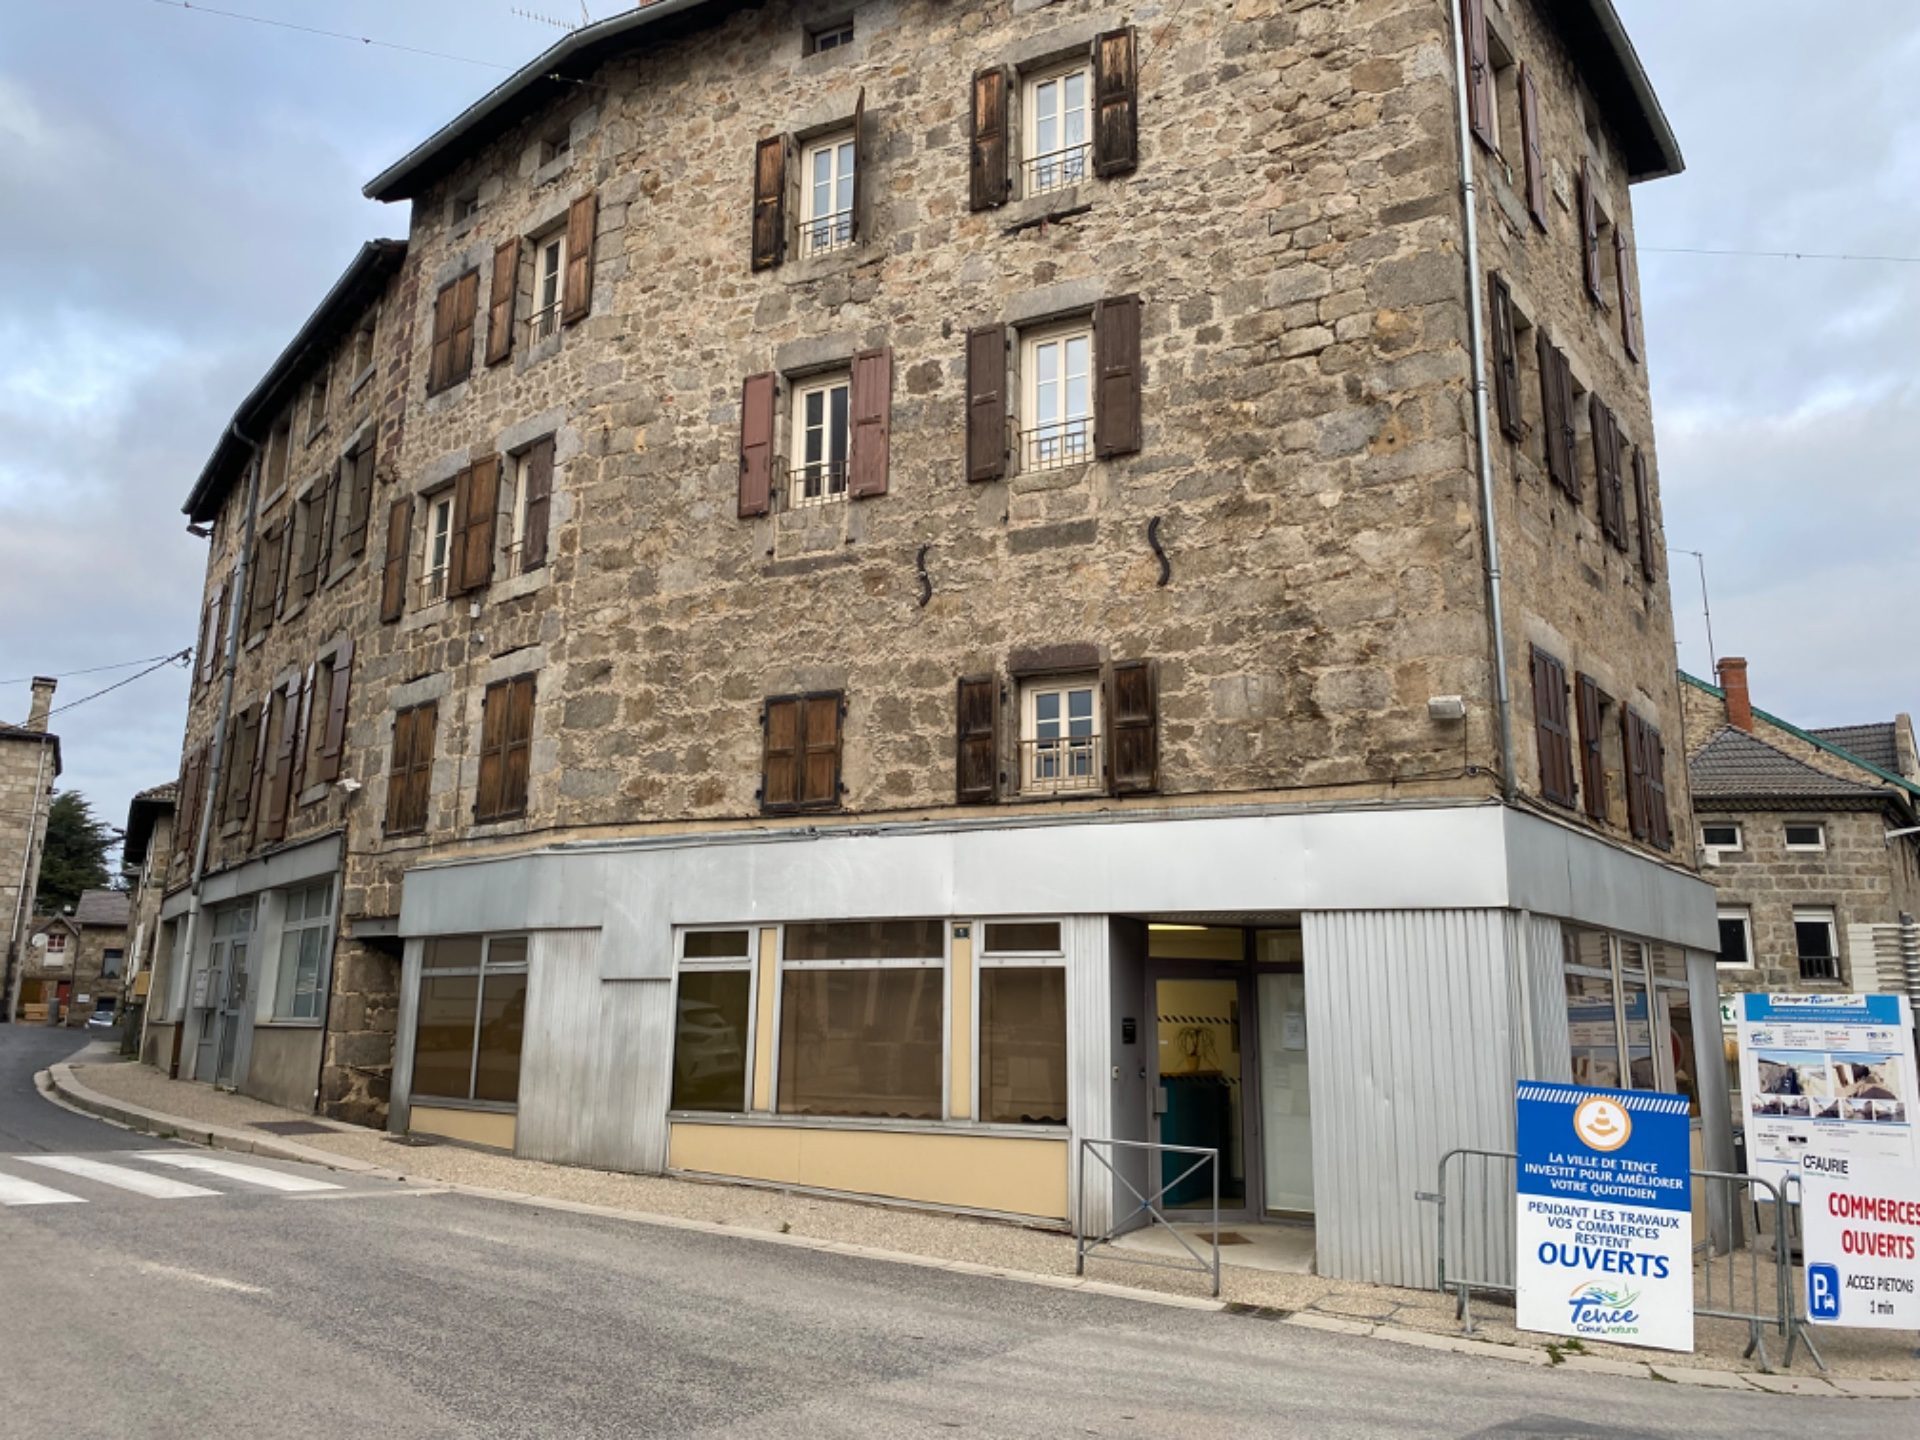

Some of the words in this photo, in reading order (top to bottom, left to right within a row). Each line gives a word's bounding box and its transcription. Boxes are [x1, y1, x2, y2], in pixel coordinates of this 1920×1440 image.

[1549, 1152, 1564, 1164] LA
[1567, 1154, 1597, 1168] VILLE
[1601, 1158, 1617, 1170] DE
[1621, 1160, 1658, 1174] TENCE
[1525, 1163, 1576, 1178] INVESTIT
[1579, 1169, 1612, 1182] POUR
[1617, 1171, 1683, 1189] AMÉLIORER
[1550, 1178, 1588, 1193] VOTRE
[1590, 1184, 1657, 1200] QUOTIDIEN
[1528, 1201, 1589, 1220] PENDANT
[1593, 1209, 1614, 1222] LES
[1619, 1211, 1680, 1229] TRAVAUX
[1828, 1191, 1920, 1227] COMMERCES
[1548, 1216, 1572, 1229] VOS
[1576, 1220, 1660, 1240] COMMERCES
[1575, 1232, 1632, 1249] RESTENT
[1841, 1229, 1916, 1260] OUVERTS
[1538, 1241, 1670, 1279] OUVERTS
[1845, 1274, 1875, 1291] ACCES
[1877, 1276, 1915, 1294] PIETONS
[1568, 1296, 1639, 1325] Tence
[1870, 1300, 1875, 1314] 1
[1877, 1300, 1894, 1315] min
